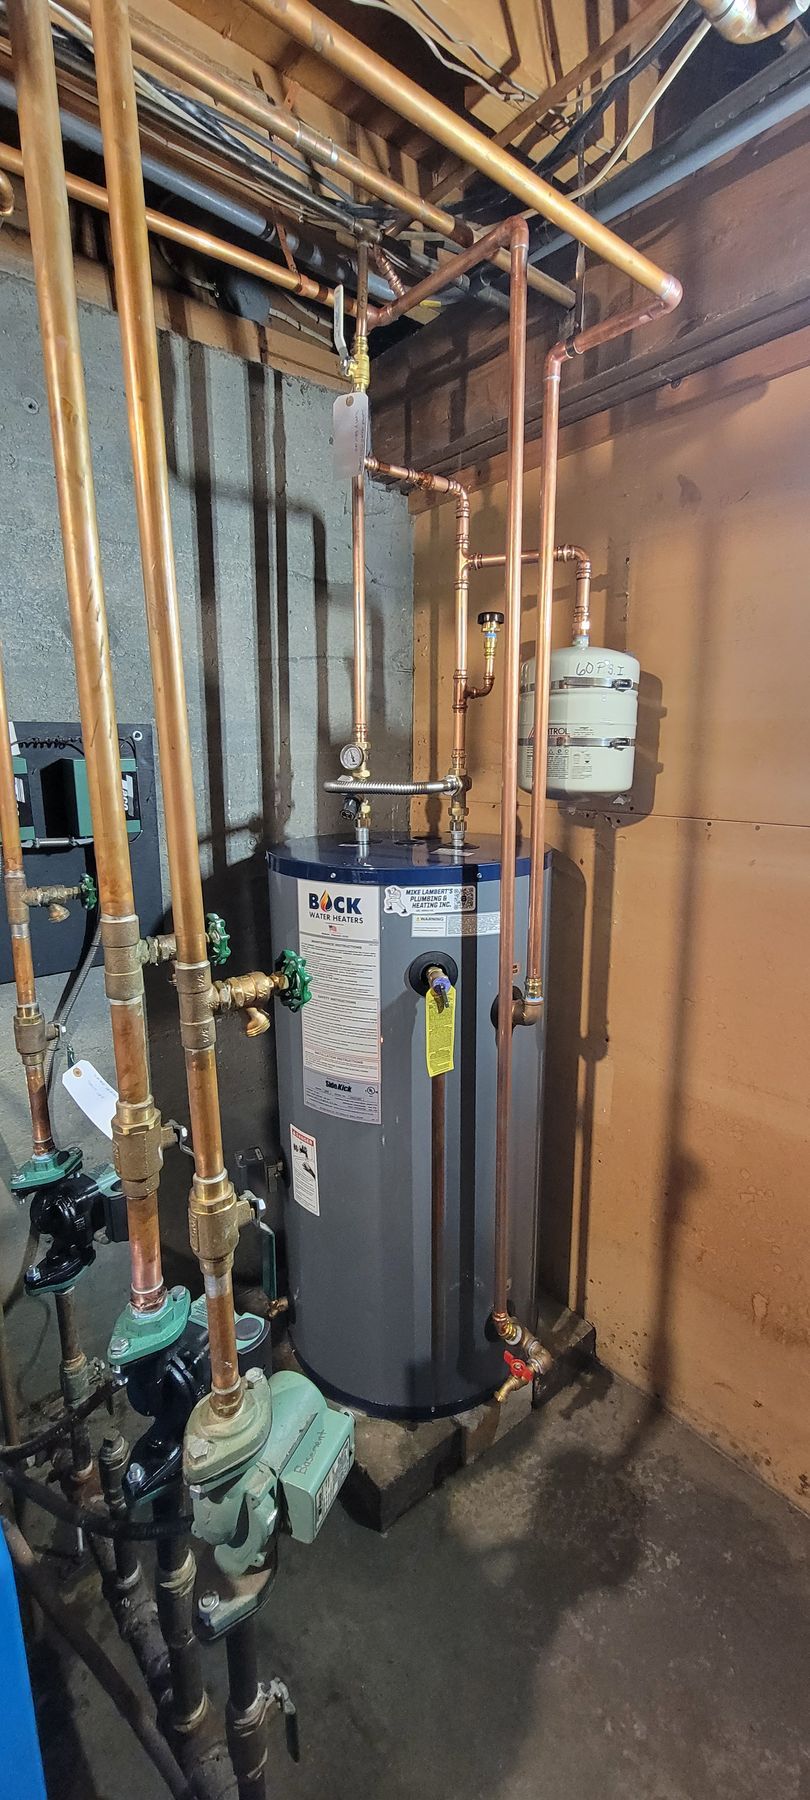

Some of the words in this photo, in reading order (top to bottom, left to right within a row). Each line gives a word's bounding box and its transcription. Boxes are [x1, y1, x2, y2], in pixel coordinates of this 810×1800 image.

[576, 661, 594, 676] 60
[308, 888, 362, 915] BOCK
[308, 911, 331, 921] WATER
[332, 915, 364, 924] HEATERS
